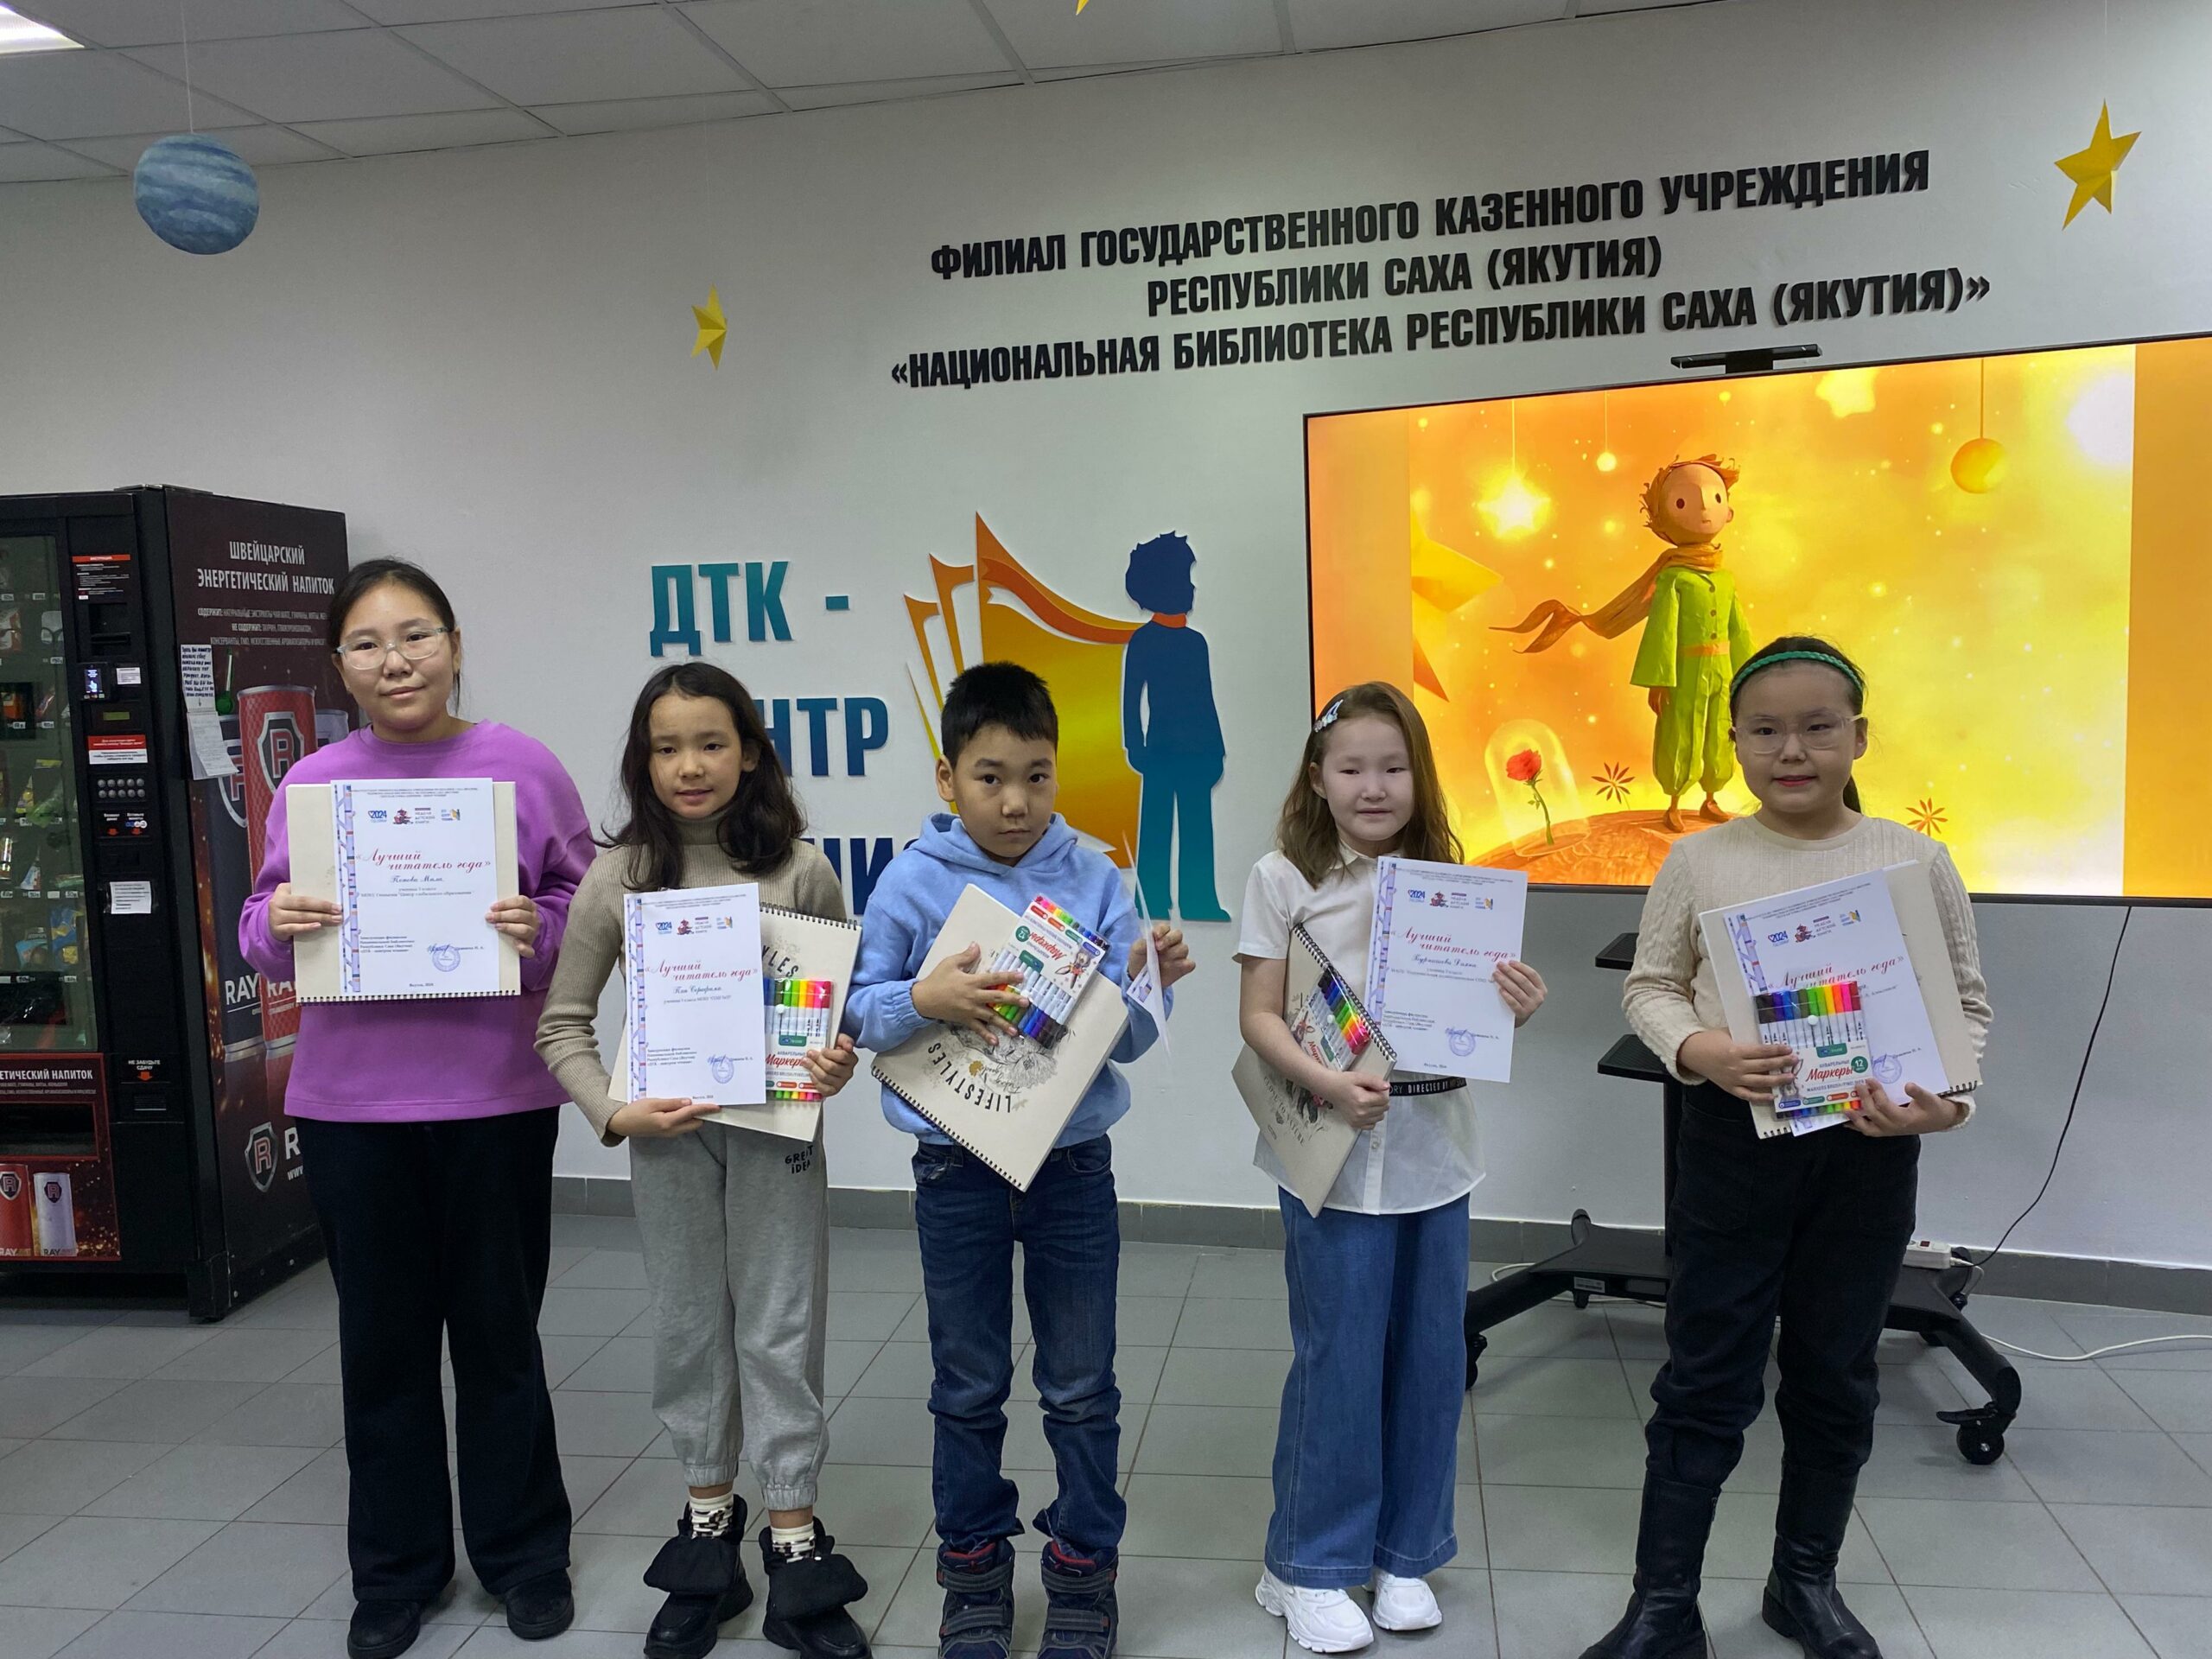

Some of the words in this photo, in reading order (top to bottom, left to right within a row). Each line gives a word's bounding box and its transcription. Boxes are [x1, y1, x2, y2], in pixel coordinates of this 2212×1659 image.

[931, 233, 1066, 280] ФИЛИАЛ
[1080, 200, 1419, 268] ГОСУДАРСТВЕННОГО
[1435, 179, 1643, 237] КАЗЕННОГО
[1659, 149, 1929, 215] УЧРЕЖДЕНИЯ
[1147, 261, 1369, 317] РЕСПУБЛИКИ
[1384, 252, 1472, 296] САХА
[1487, 235, 1662, 290] (ЯКУТИЯ)
[891, 335, 1160, 390] «НАЦИОНАЛЬНАЯ
[1173, 315, 1393, 370] БИБЛИОТЕКА
[1407, 296, 1645, 351] РЕСПУБЛИКИ
[1662, 286, 1758, 332] САХА
[1773, 267, 1990, 327] (ЯКУТИЯ)»
[229, 541, 305, 565] ШВЕЙЦАРСКИЙ
[198, 568, 289, 592] ЭНЕРГЕТИЧЕСКИЙ
[293, 575, 334, 594] НАПИТОК
[650, 561, 792, 657] ДТК
[753, 696, 888, 777] НТР
[356, 849, 421, 868] «Лучший
[387, 861, 453, 871] читатель
[456, 860, 491, 873] года»
[1391, 926, 1452, 944] «Лучший
[1420, 943, 1479, 955] читатель
[645, 959, 701, 976] «Лучший
[1768, 963, 1834, 989] «Лучший
[1871, 956, 1904, 976] года»
[673, 971, 727, 982] читатель
[52, 1070, 93, 1080] НАПИТОК
[928, 1042, 1012, 1113] LIFESTYLES
[1806, 1066, 1853, 1083] Маркеры
[1408, 1082, 1440, 1094] DIRECTED
